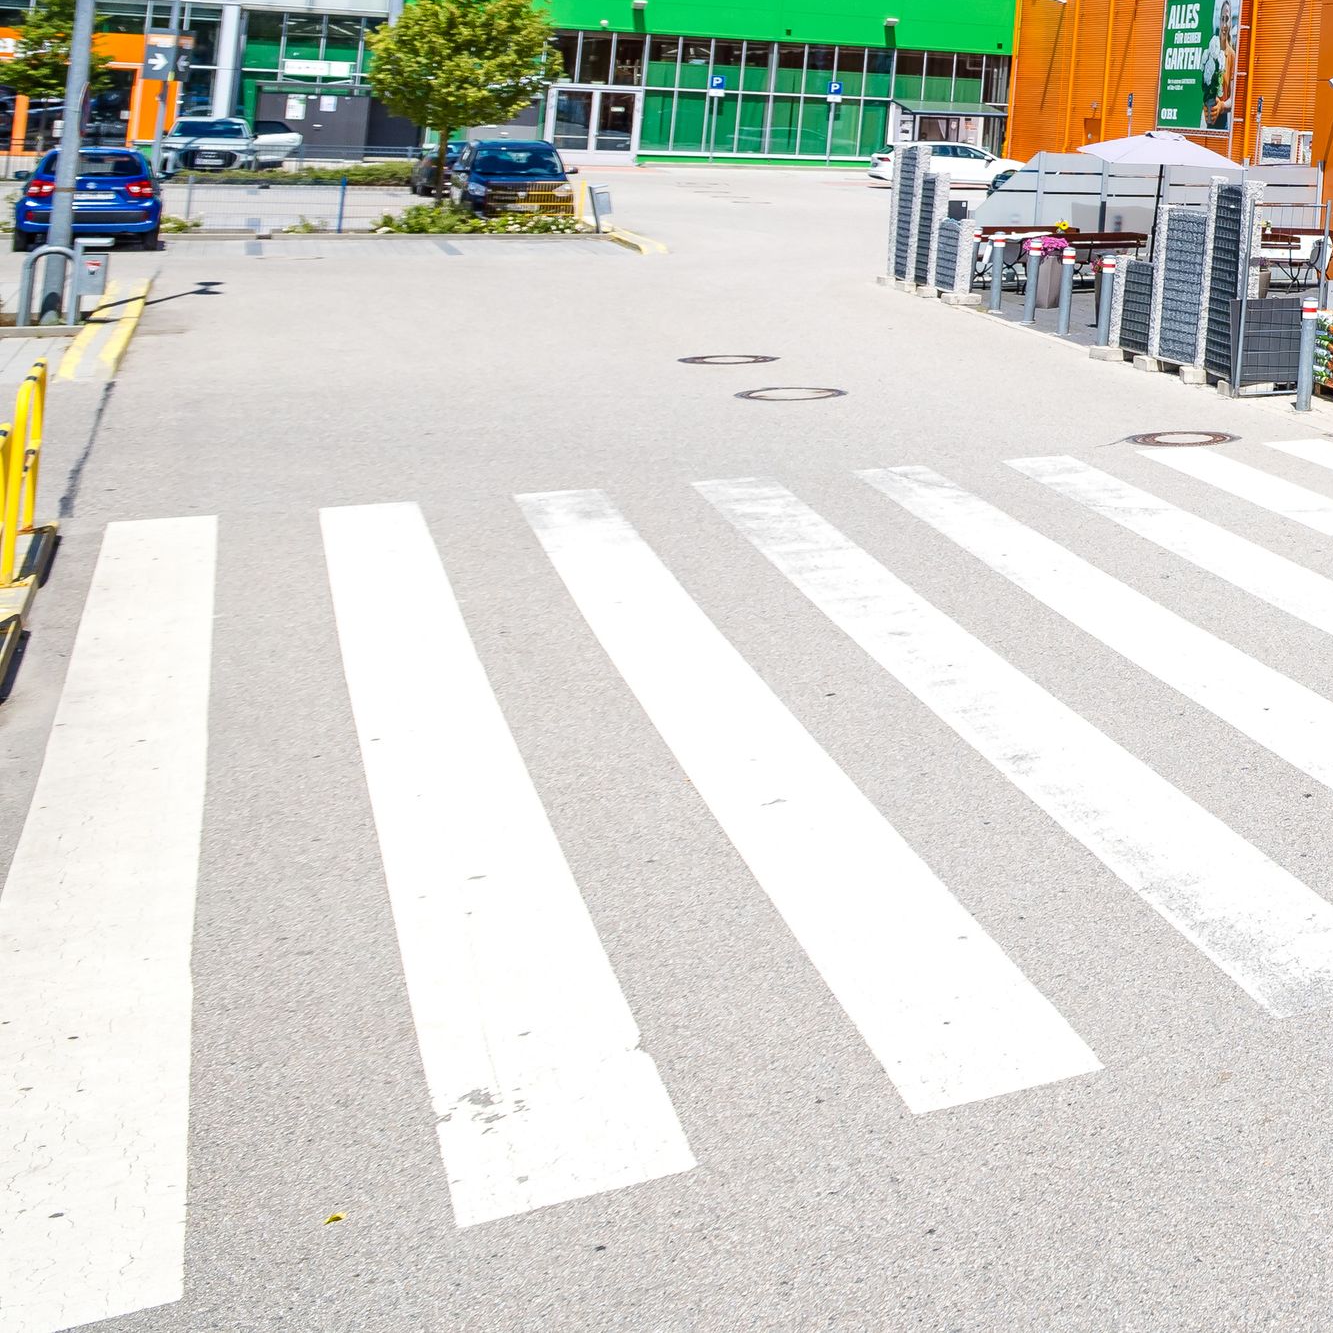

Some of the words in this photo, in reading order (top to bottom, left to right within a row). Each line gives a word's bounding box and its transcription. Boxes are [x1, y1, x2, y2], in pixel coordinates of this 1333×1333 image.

[1167, 3, 1200, 30] ALLES
[1164, 47, 1202, 70] GARTEN
[712, 77, 723, 87] P
[830, 83, 840, 93] P
[1160, 107, 1178, 120] OBI
